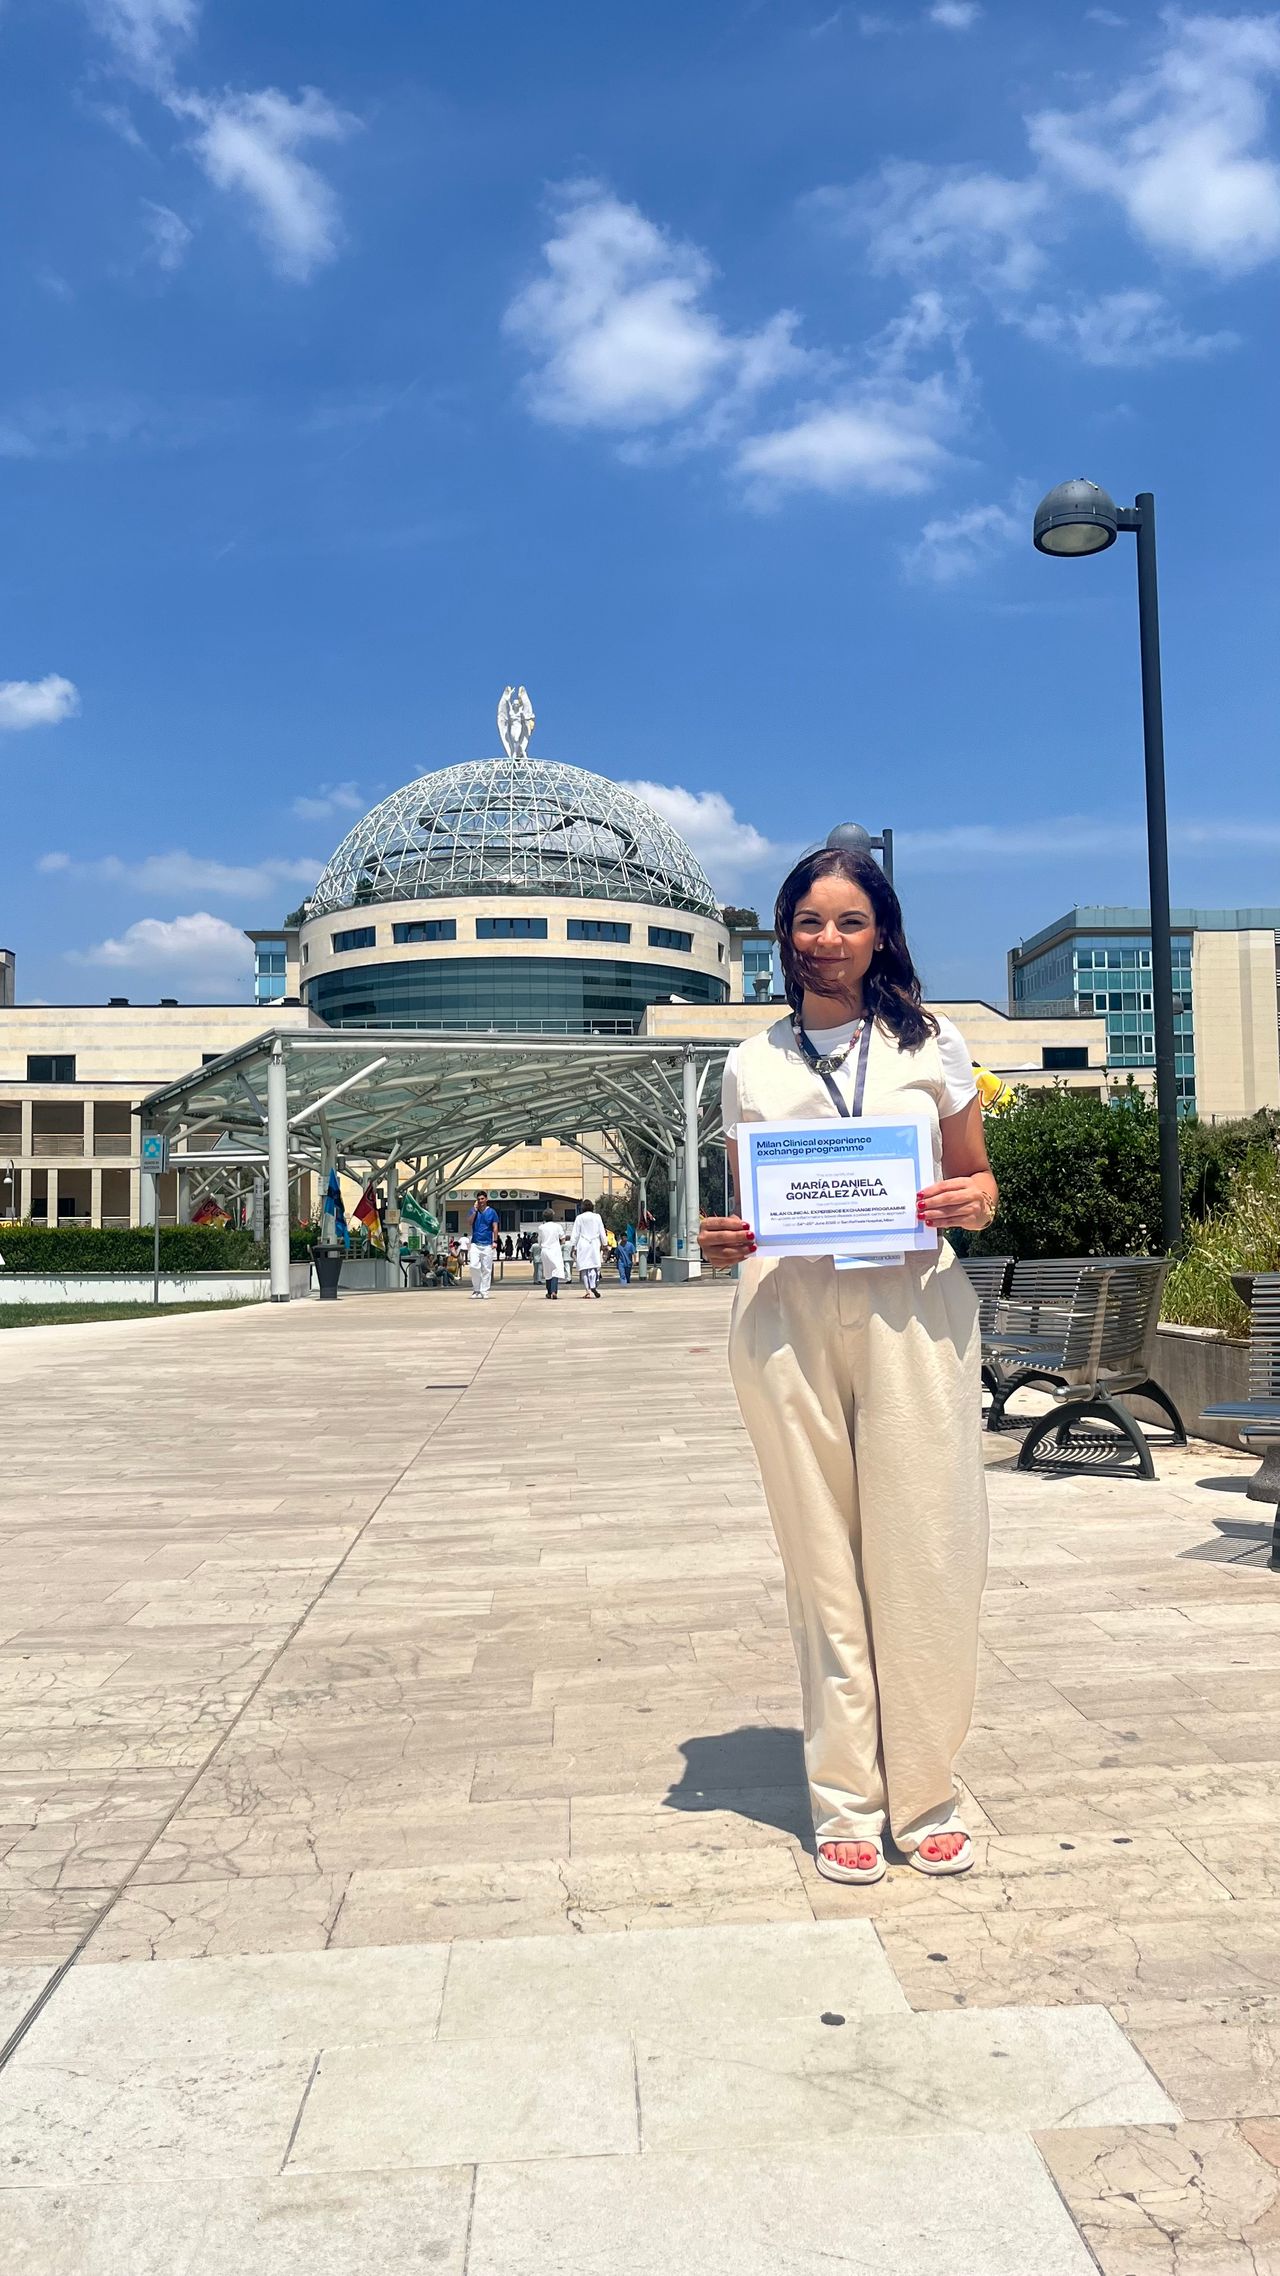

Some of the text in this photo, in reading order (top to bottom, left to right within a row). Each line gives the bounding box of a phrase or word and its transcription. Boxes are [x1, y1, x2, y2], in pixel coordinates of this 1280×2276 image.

[756, 1136, 872, 1149] Milan Clinical experience
[757, 1145, 864, 1156] exchange programme
[791, 1178, 883, 1190] MARÍA DANIELA
[786, 1186, 888, 1200] GONZÁLEZ ÁVILA
